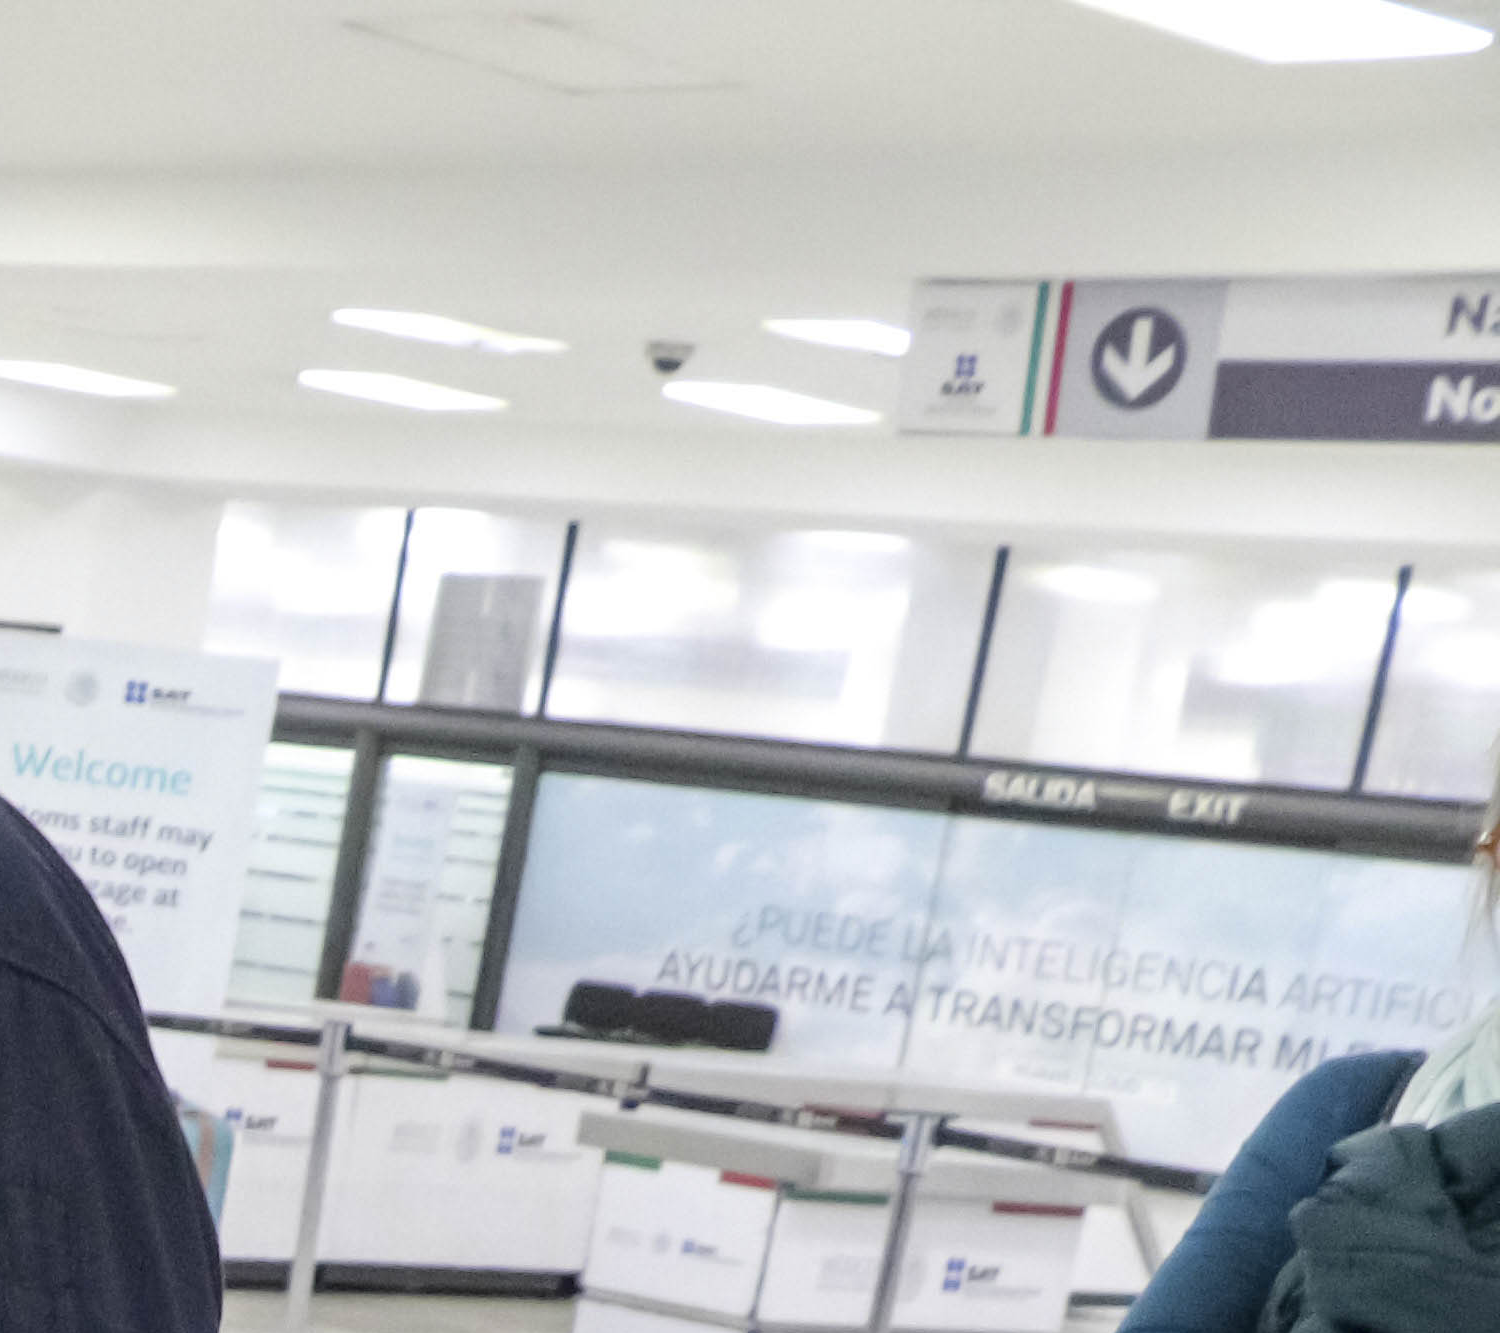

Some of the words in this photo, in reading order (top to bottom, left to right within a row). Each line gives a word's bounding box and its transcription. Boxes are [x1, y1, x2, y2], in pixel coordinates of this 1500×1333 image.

[12, 742, 193, 796] Welcome
[984, 770, 1096, 812] SALIDA
[1168, 788, 1247, 825] EXIT
[89, 813, 152, 840] staff
[156, 823, 217, 853] may
[90, 845, 116, 867] to
[123, 850, 188, 877] open
[731, 903, 893, 956] ¿PUEDE
[966, 932, 1268, 1005] INTELIGENCIA
[656, 949, 874, 1012] AYUDARME
[883, 982, 915, 1017] A
[927, 984, 1263, 1069] TRANSFORMAR
